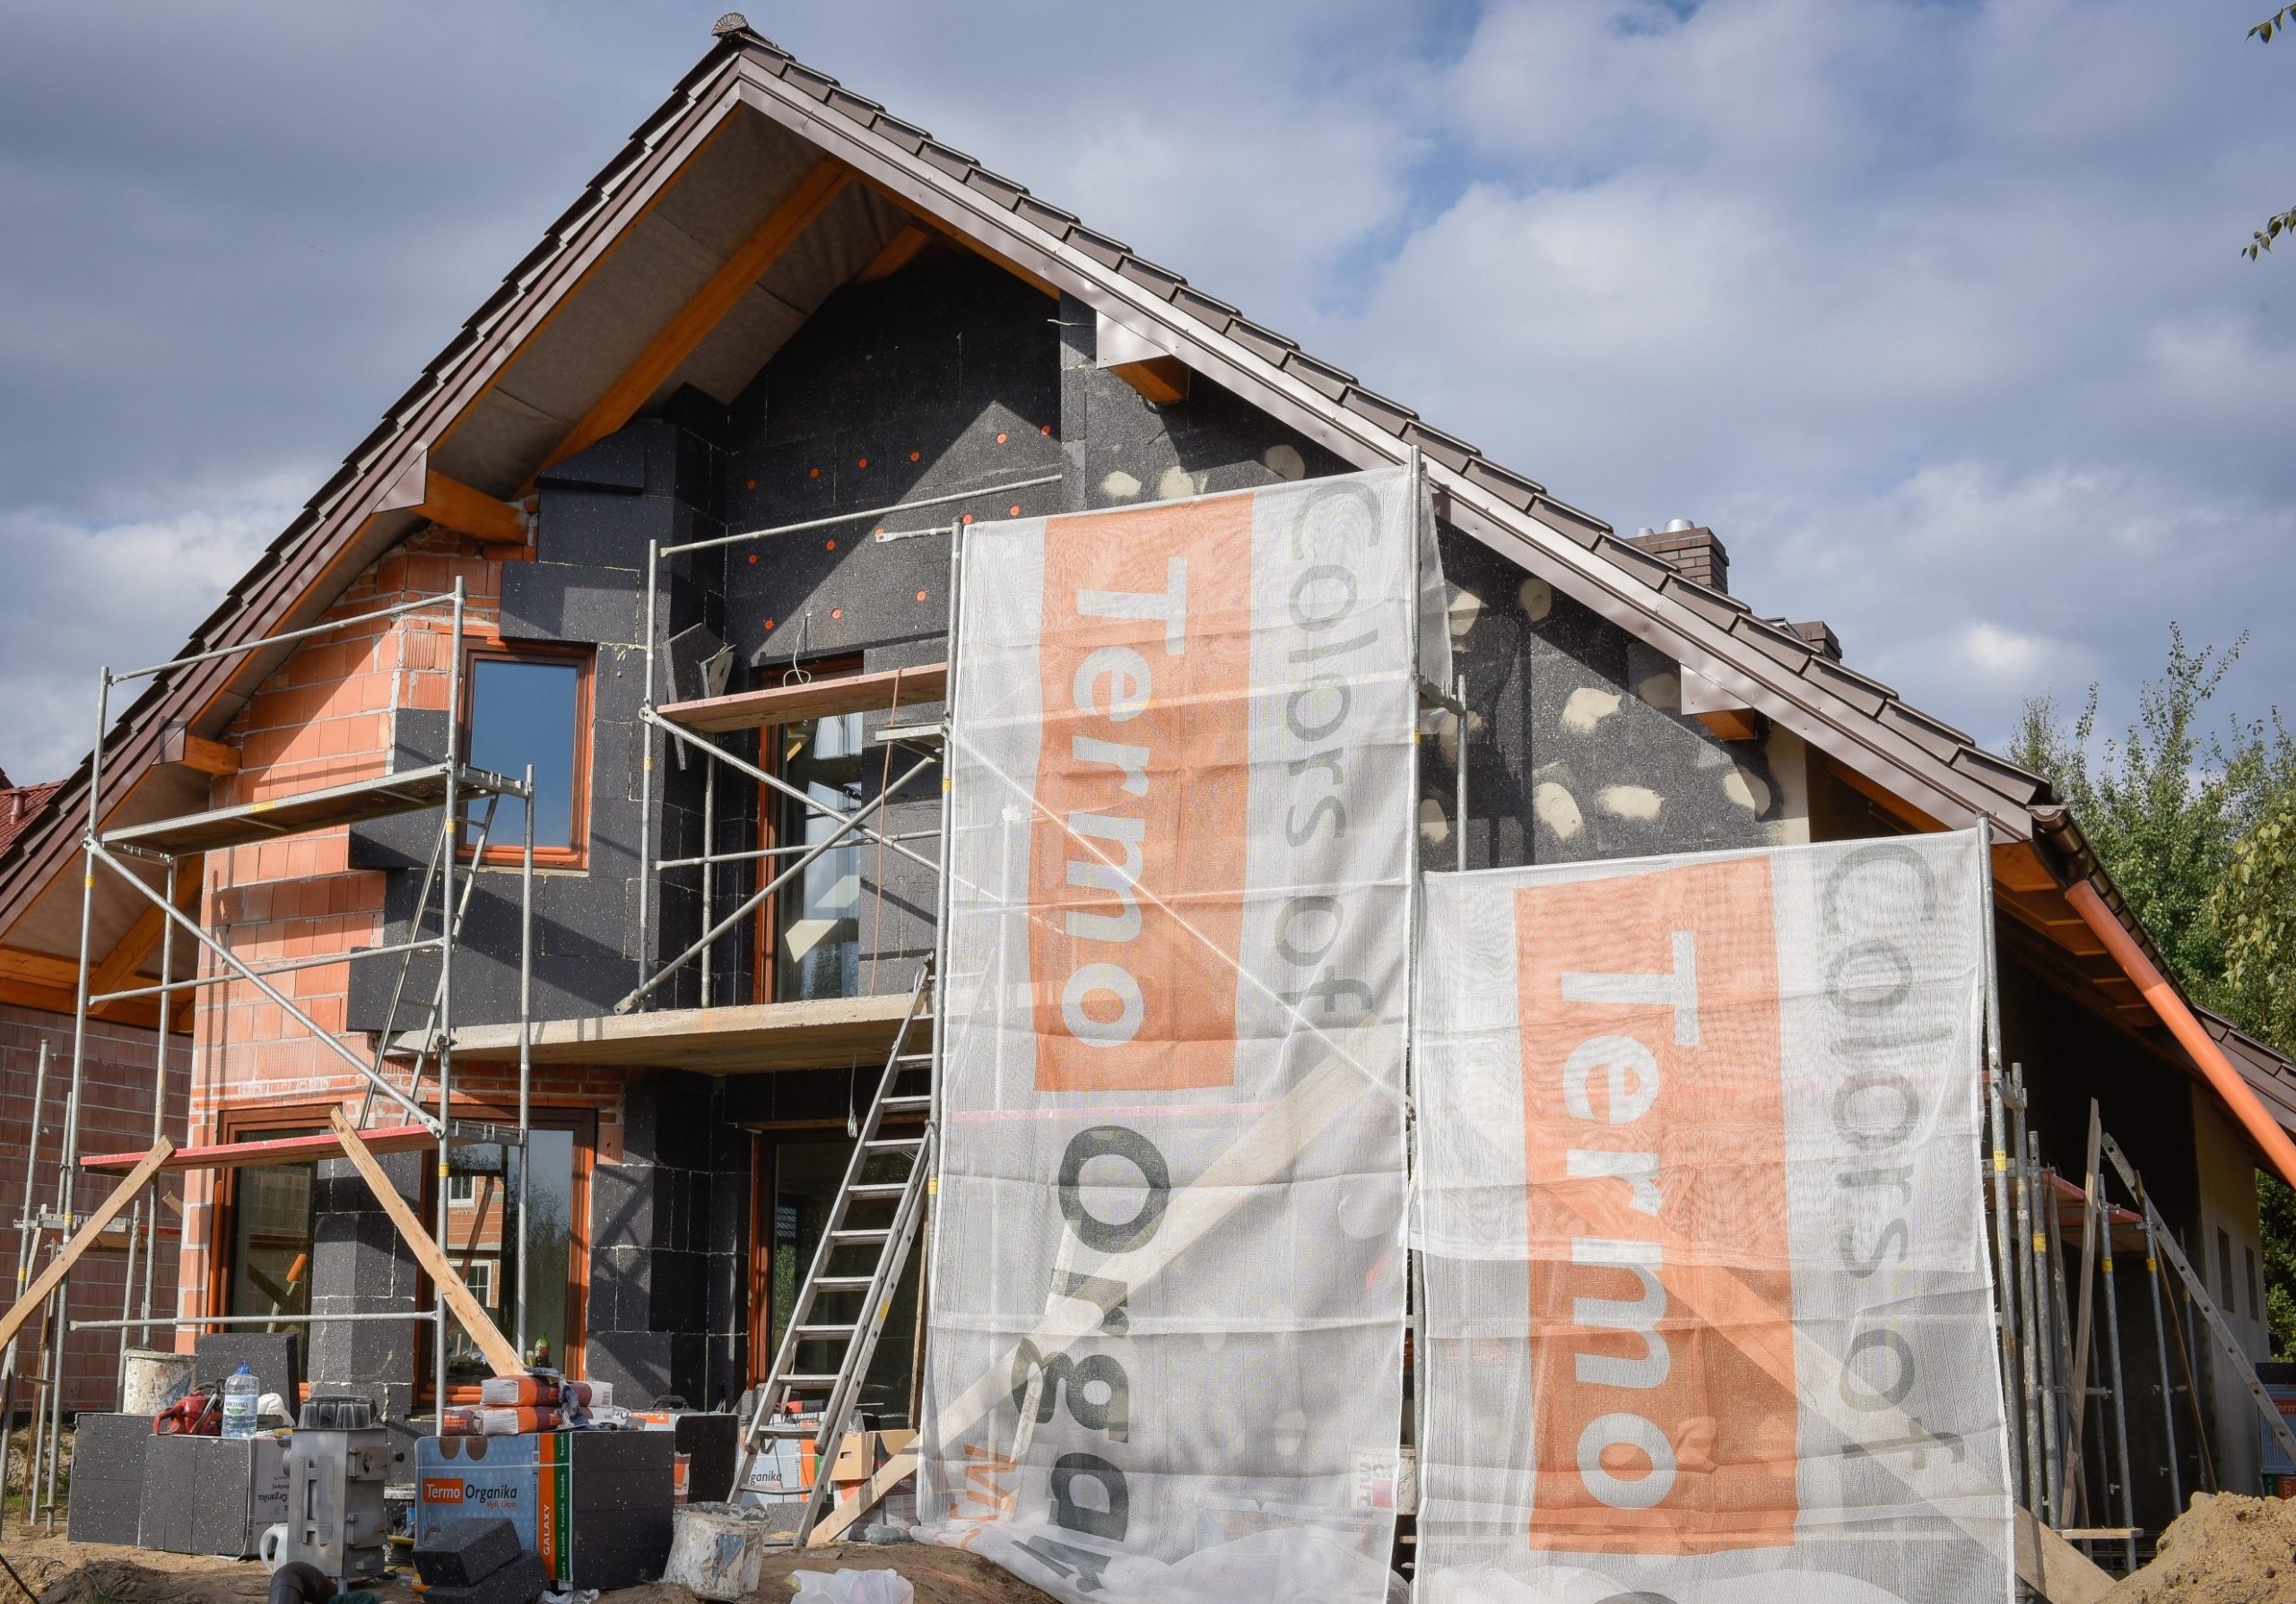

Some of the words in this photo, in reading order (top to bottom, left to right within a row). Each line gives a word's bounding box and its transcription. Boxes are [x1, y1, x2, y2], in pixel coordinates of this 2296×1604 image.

[1287, 479, 1380, 848] Colors
[1062, 555, 1187, 1048] Termo
[1275, 895, 1373, 1014] of
[1823, 843, 1953, 1279] Colors
[1560, 929, 1700, 1509] Termo
[1839, 1329, 1964, 1471] of
[258, 1491, 288, 1503] Organika
[426, 1483, 460, 1499] Termo
[465, 1485, 517, 1504] Organika
[543, 1504, 551, 1556] GALAXY
[751, 1470, 782, 1486] ganika
